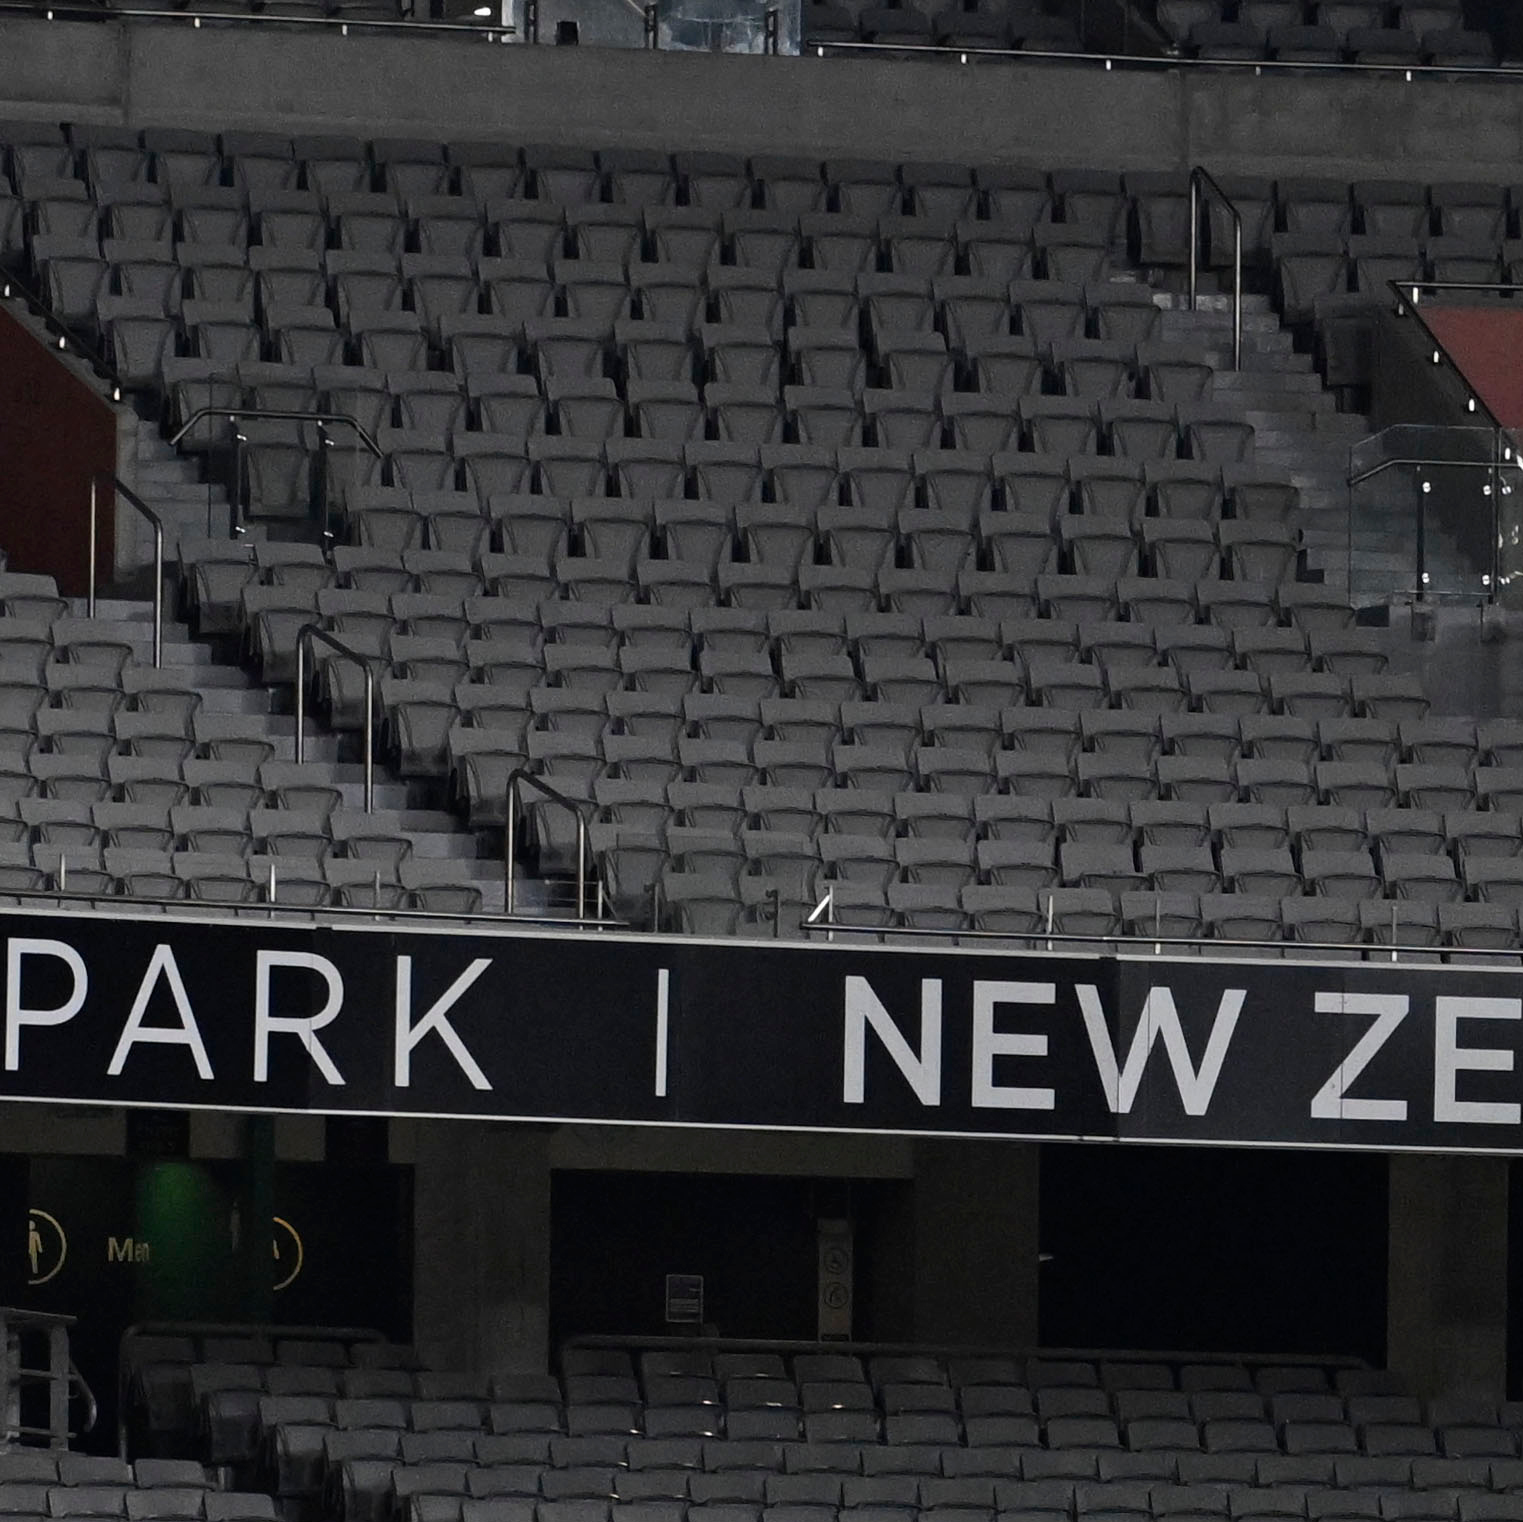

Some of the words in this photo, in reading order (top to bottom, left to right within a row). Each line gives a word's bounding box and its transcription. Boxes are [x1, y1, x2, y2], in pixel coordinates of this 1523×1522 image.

[4, 937, 494, 1091] PARK
[843, 975, 1248, 1117] NEW
[108, 1236, 150, 1263] Men
